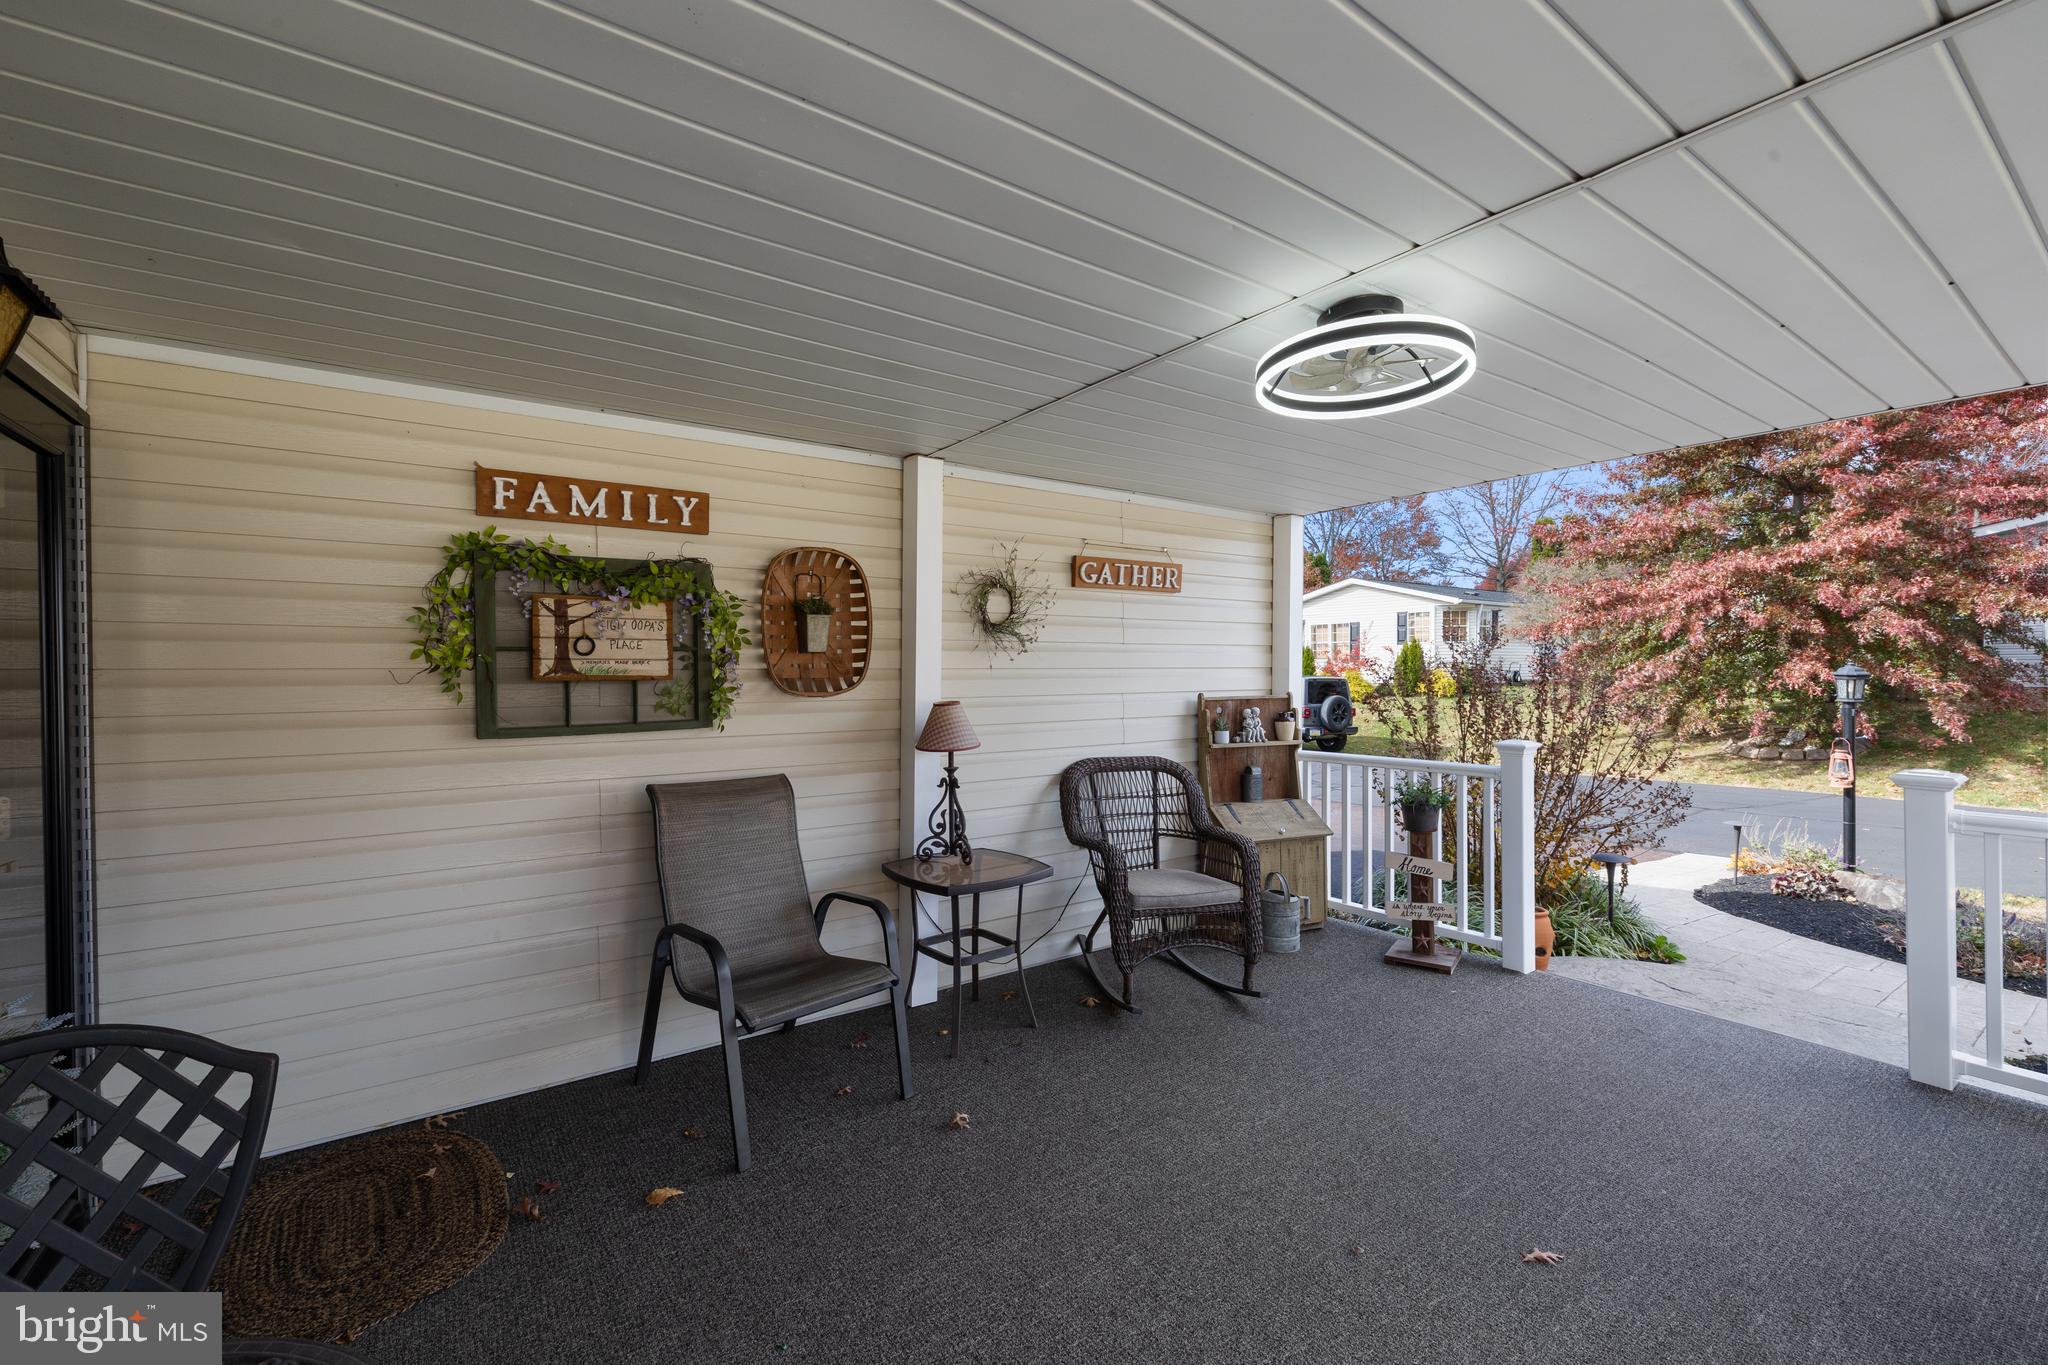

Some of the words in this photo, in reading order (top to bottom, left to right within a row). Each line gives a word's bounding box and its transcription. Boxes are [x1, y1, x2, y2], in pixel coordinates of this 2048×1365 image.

[492, 476, 699, 526] FAMILY
[1080, 561, 1180, 589] GATHER
[631, 620, 664, 632] OOPA'S
[609, 640, 643, 650] PLACE
[1399, 856, 1434, 876] Home
[1403, 903, 1424, 912] where
[1427, 905, 1446, 913] your
[1400, 911, 1422, 919] story
[1428, 910, 1453, 920] begins
